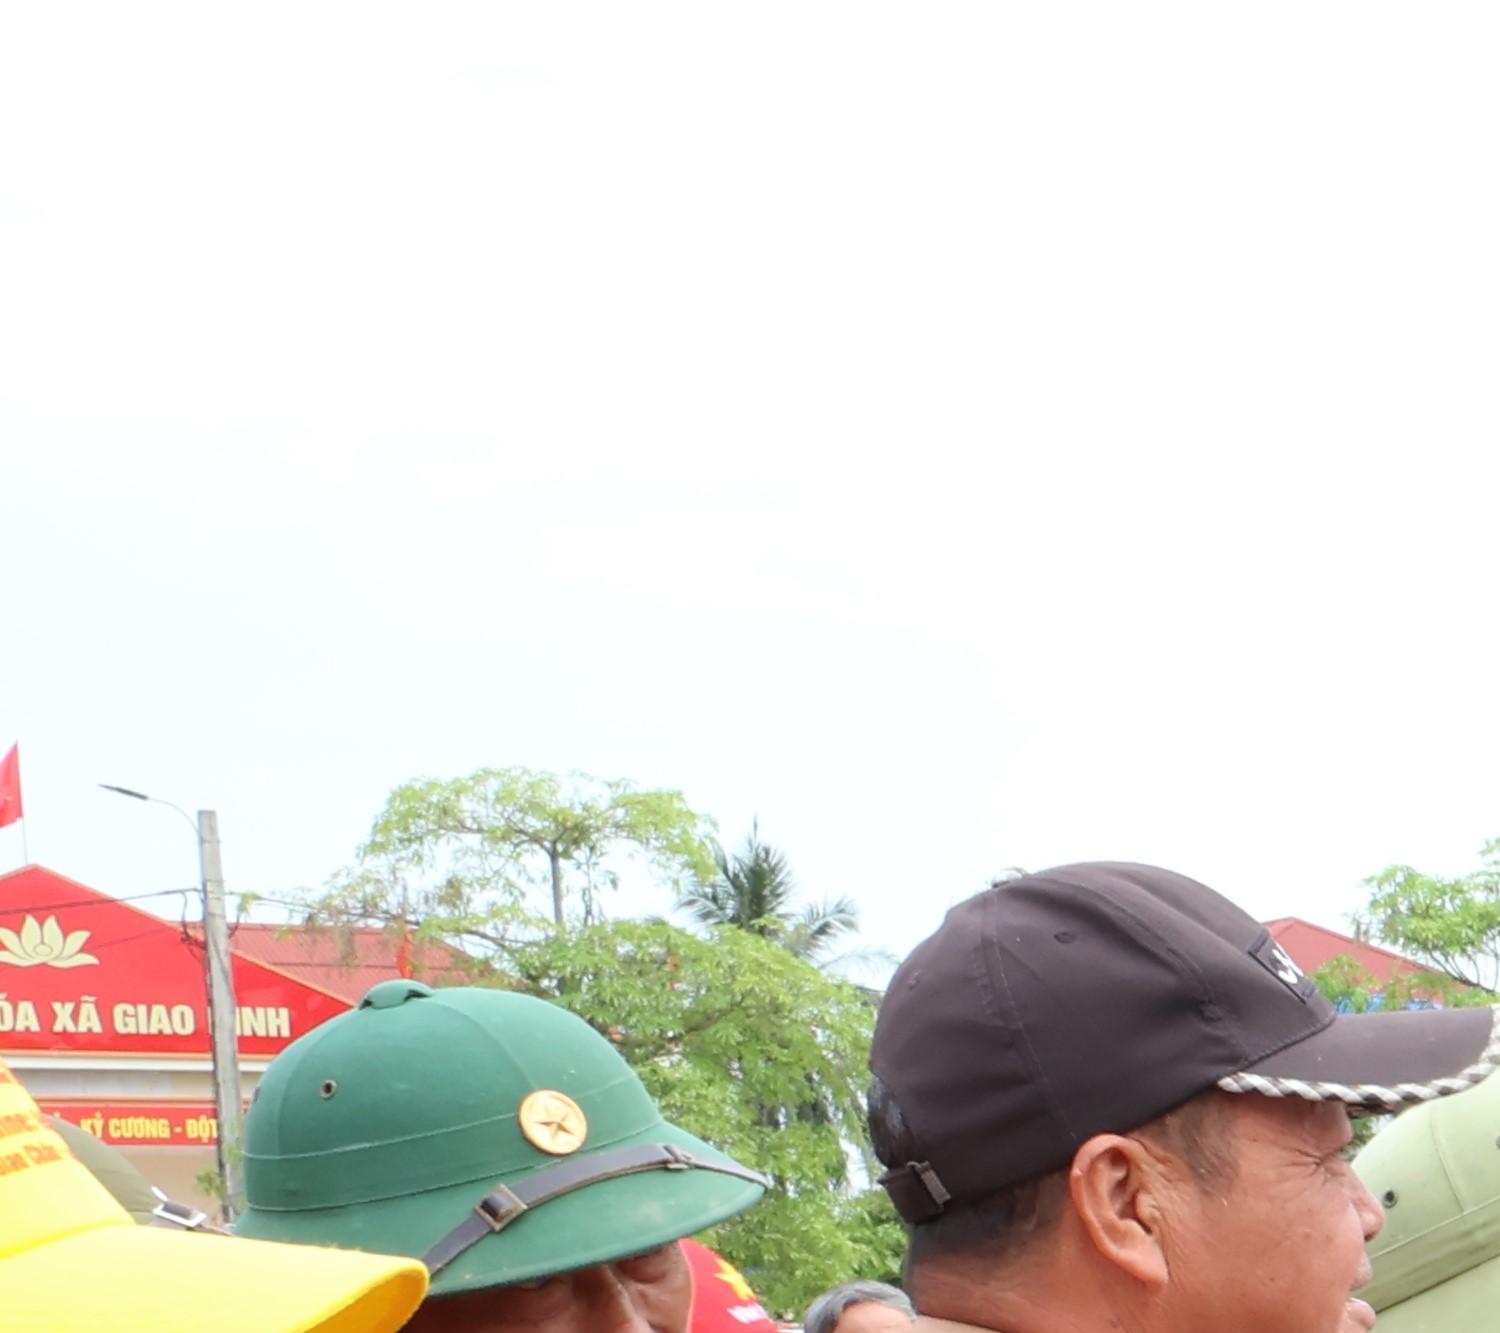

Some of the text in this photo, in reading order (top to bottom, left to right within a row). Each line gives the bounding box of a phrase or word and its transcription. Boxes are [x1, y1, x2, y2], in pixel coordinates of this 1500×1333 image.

[52, 996, 102, 1033] XÃ
[113, 1004, 195, 1036] GIAO
[208, 1006, 291, 1037] INH
[109, 1117, 171, 1138] CƯƠNG
